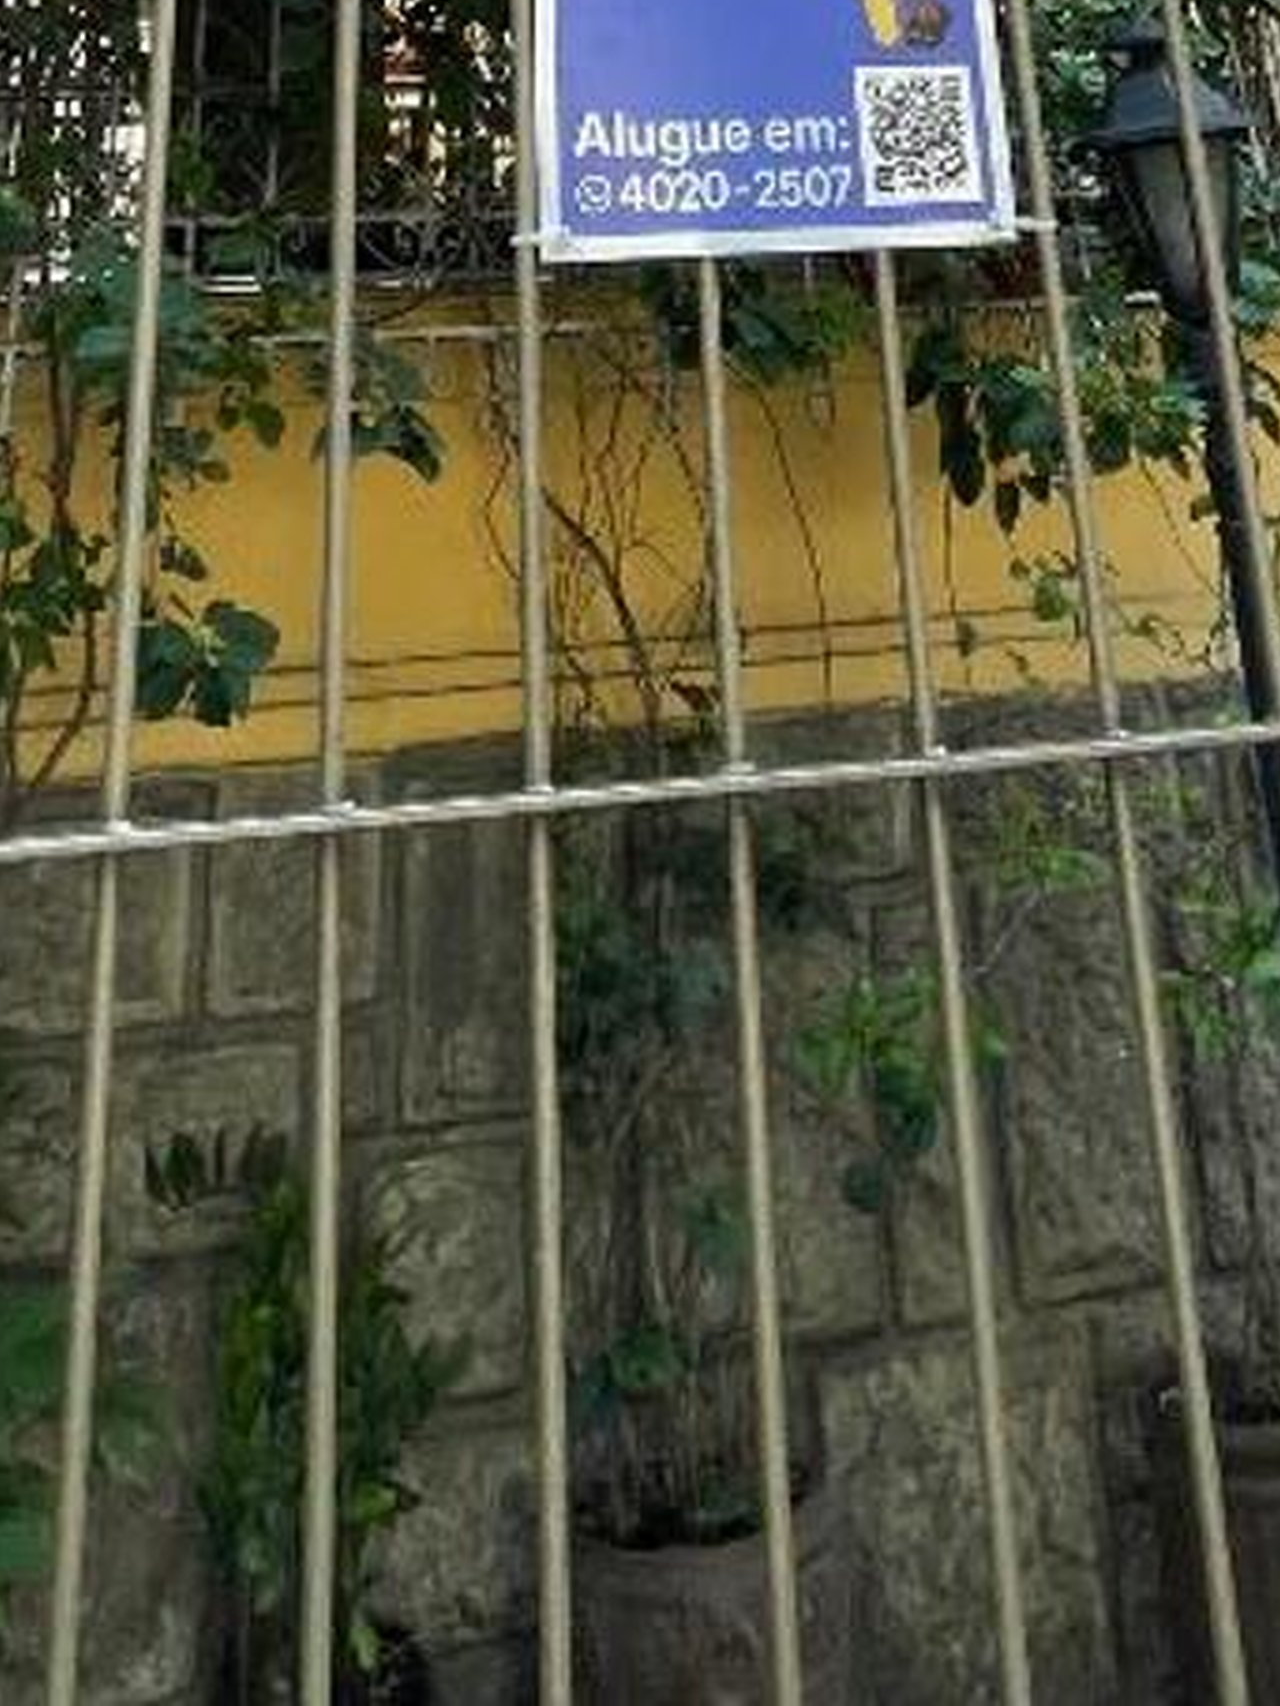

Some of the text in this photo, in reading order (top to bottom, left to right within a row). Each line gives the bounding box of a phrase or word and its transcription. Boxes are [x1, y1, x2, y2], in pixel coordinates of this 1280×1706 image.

[575, 113, 850, 164] Alugue em:
[621, 167, 852, 211] 4020-2507
